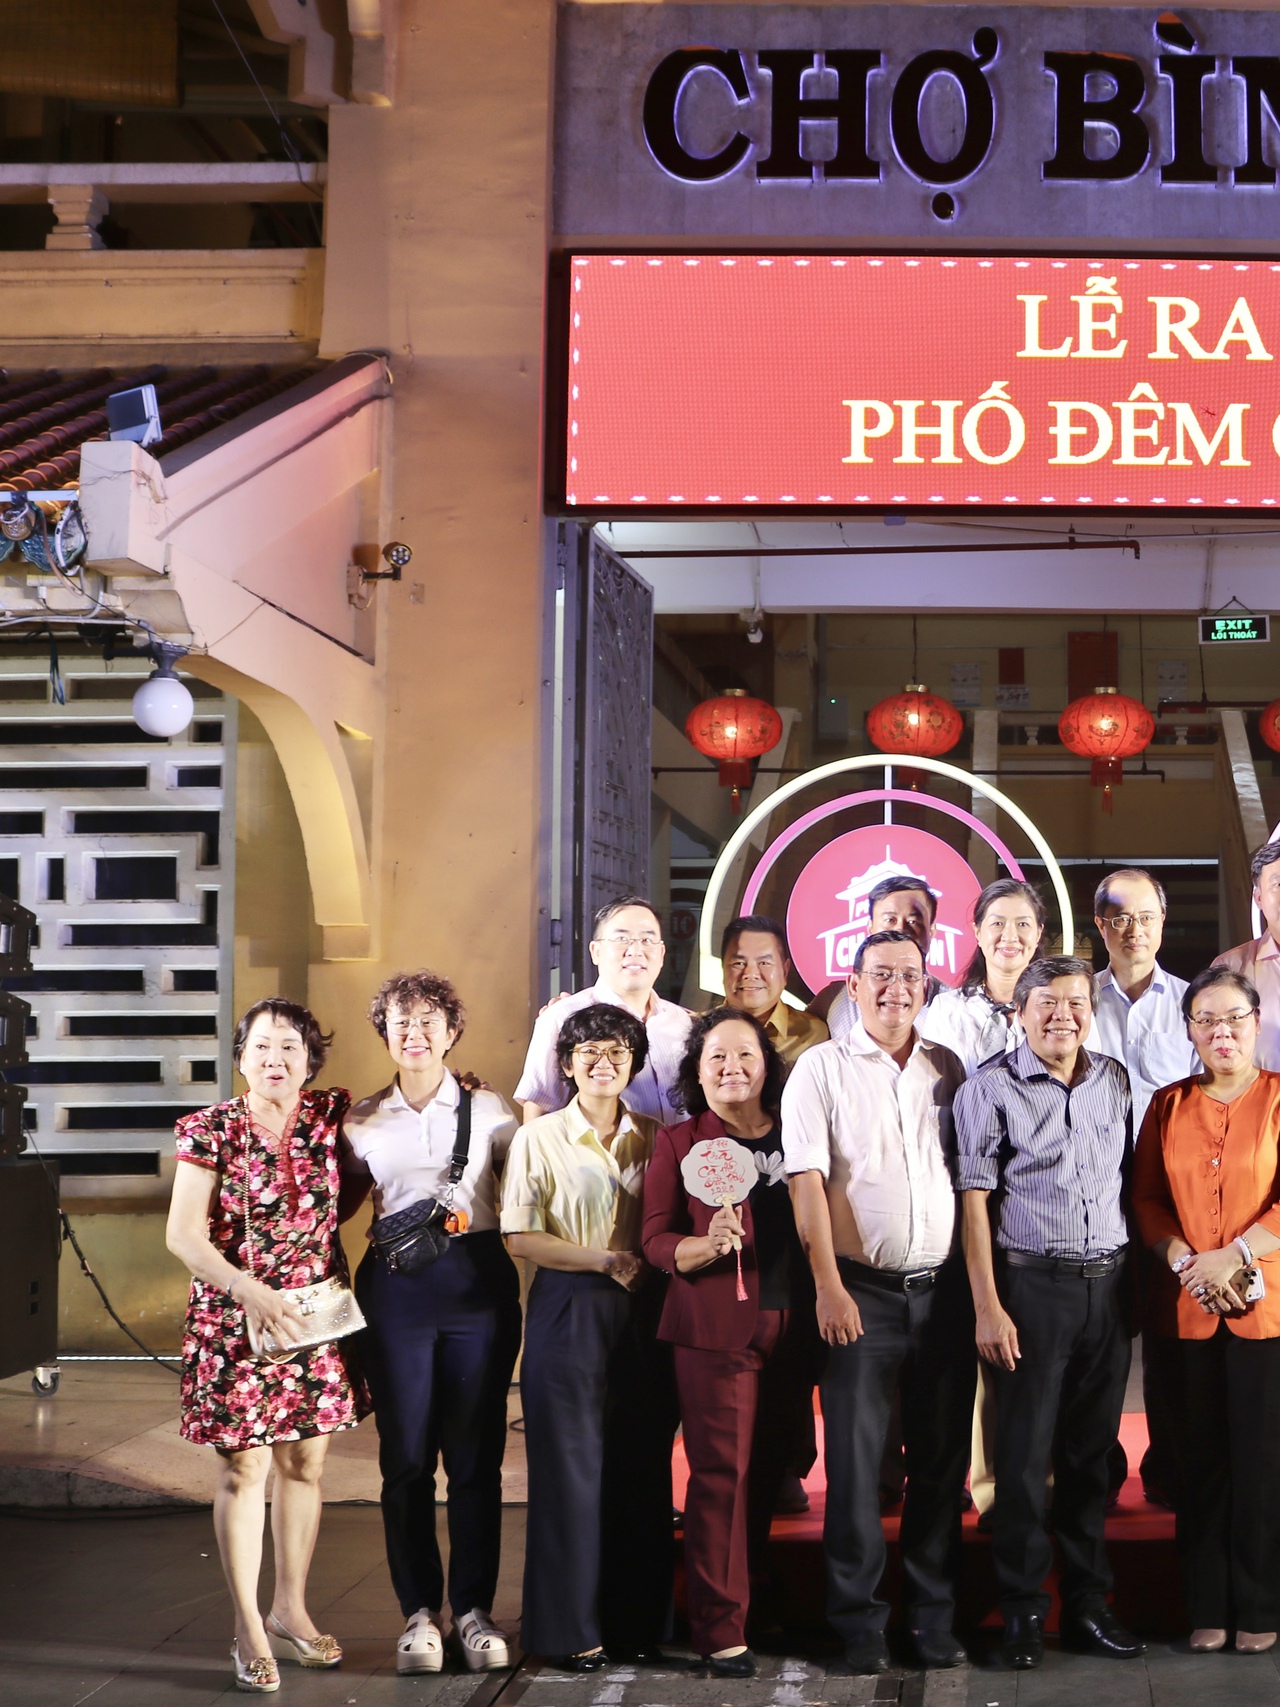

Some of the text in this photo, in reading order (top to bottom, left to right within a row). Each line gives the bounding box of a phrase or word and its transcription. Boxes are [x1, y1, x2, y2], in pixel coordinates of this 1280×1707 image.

[643, 26, 998, 221] CHỢ
[1016, 276, 1128, 359] LỄ
[1148, 297, 1273, 361] RA
[842, 380, 1026, 465] PHỐ
[1048, 383, 1251, 467] ĐÊM
[1215, 619, 1253, 630] EXIT
[1229, 630, 1258, 639] THOÁT
